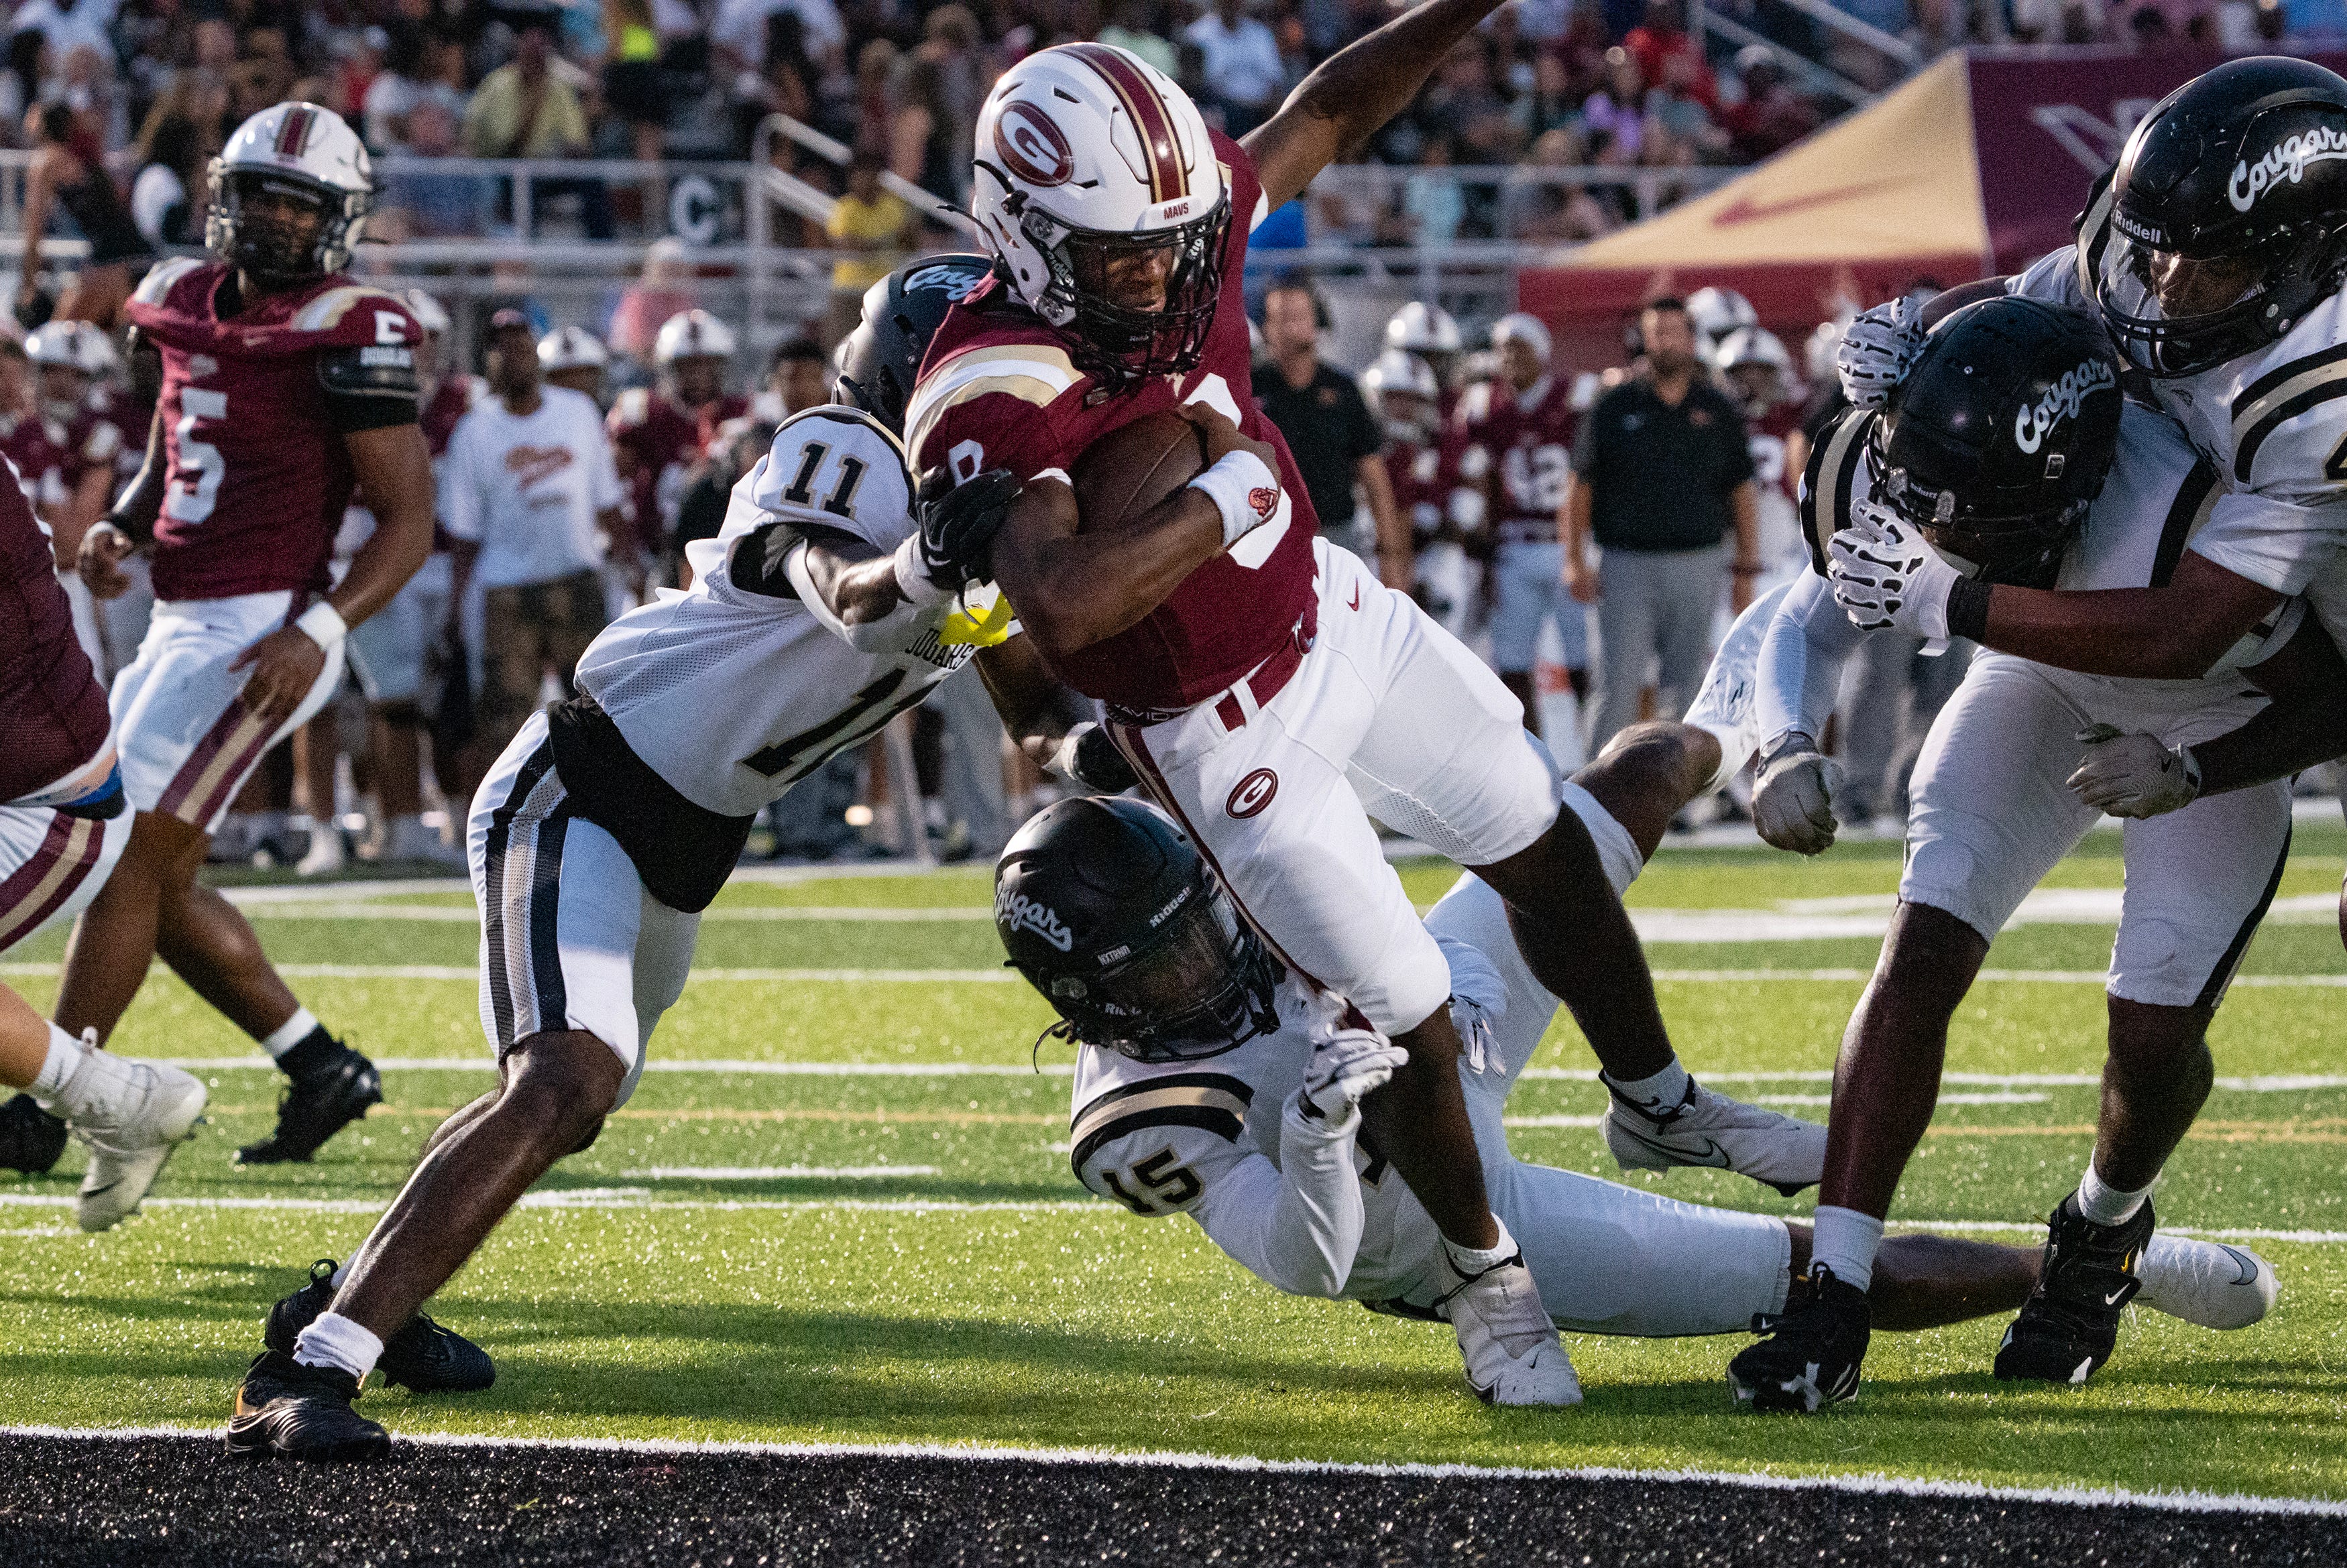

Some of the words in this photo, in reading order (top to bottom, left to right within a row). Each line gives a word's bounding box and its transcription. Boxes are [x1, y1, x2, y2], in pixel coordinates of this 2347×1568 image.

[1001, 110, 1061, 177] G
[1163, 202, 1189, 221] MAVS
[2114, 209, 2162, 244] Riddell
[903, 264, 981, 300] Coug
[2015, 357, 2116, 455] Cougars
[168, 387, 228, 525] 5
[780, 439, 870, 521] 11
[1232, 775, 1273, 813] G
[994, 888, 1072, 952] ougars
[1149, 886, 1192, 928] Riddell
[1098, 1142, 1205, 1217] 15
